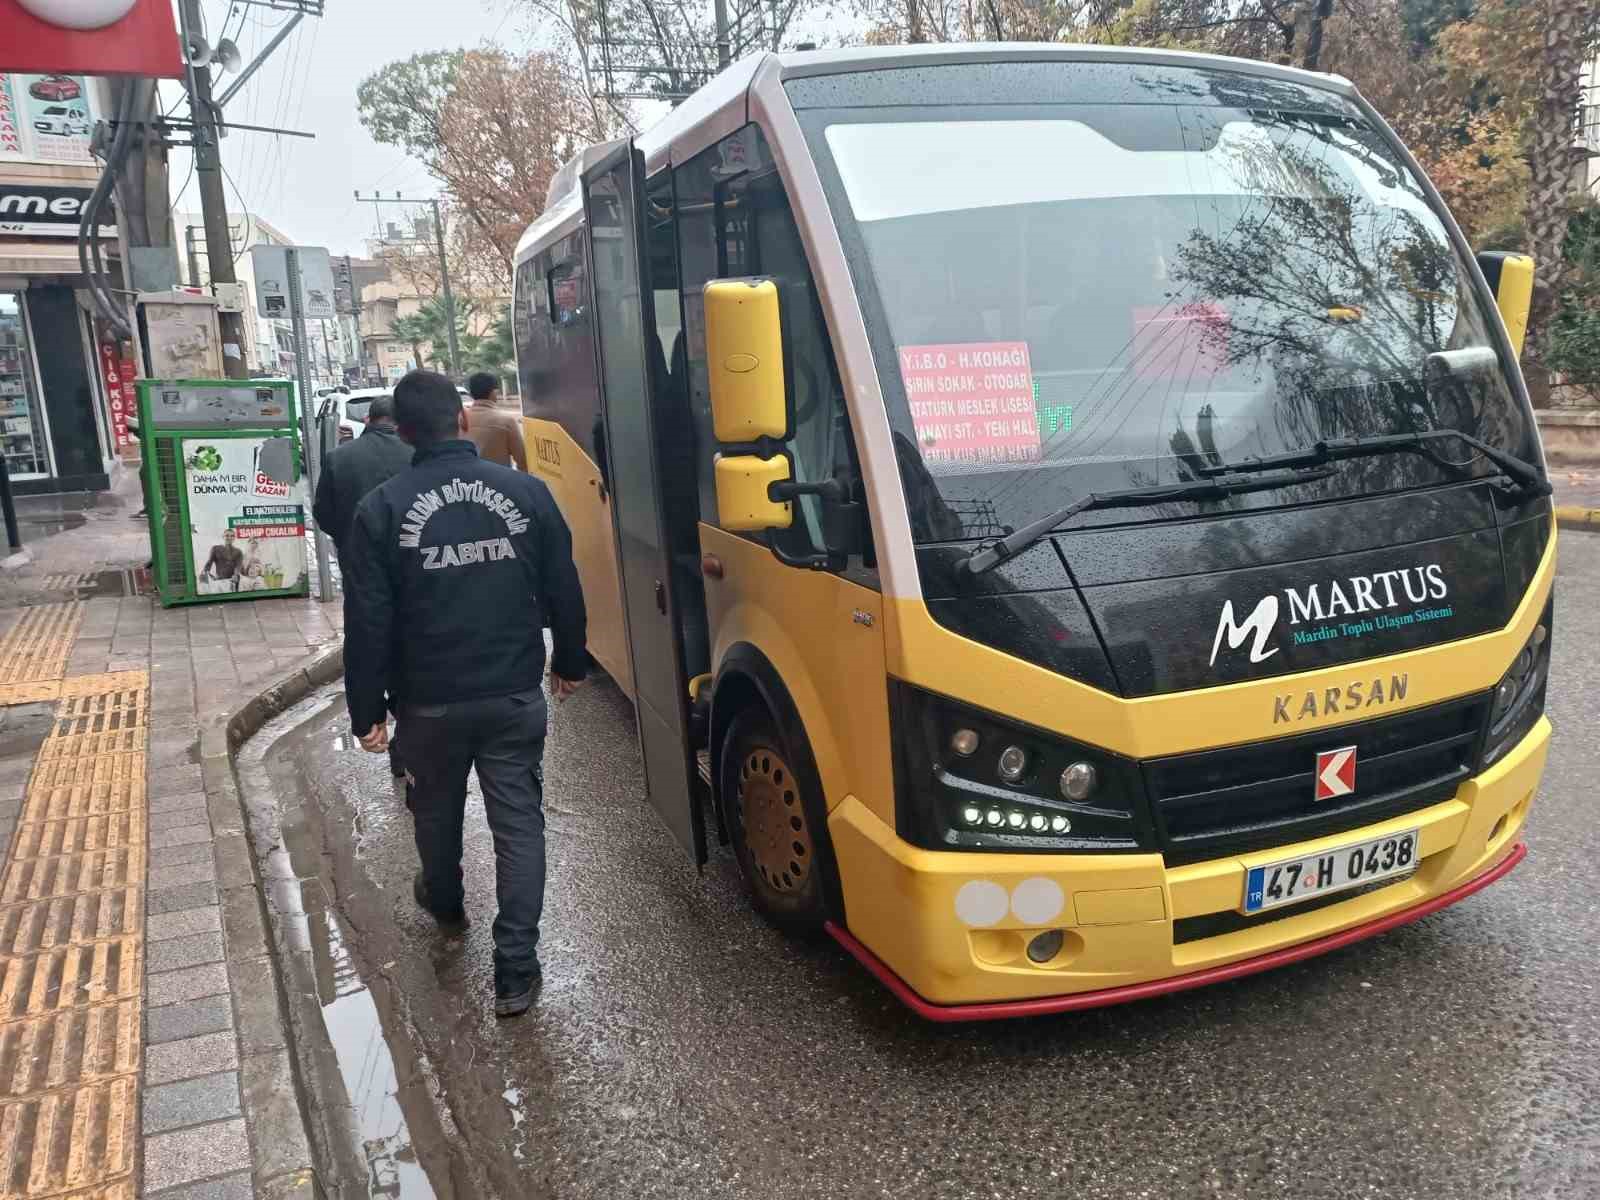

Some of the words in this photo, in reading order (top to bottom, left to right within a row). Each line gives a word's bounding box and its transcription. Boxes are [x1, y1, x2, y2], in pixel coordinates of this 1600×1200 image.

[193, 474, 217, 483] DAHA
[194, 484, 227, 494] DÜNYA
[255, 485, 287, 497] KAZAN
[399, 489, 445, 548] MARDİN
[441, 478, 531, 536] BÜYÜKŞEHİR
[420, 537, 517, 570] ZABITA
[1284, 564, 1448, 625] MARTUS
[1293, 625, 1339, 646] Mardin
[1339, 619, 1374, 640] Toplu
[1375, 612, 1415, 632] Ulaşım
[1415, 603, 1454, 622] Sistemi
[1272, 672, 1409, 724] KARSAN
[1266, 863, 1303, 899] 47
[1317, 855, 1335, 889] H
[1347, 834, 1414, 880] 0438
[1250, 892, 1263, 901] TR
